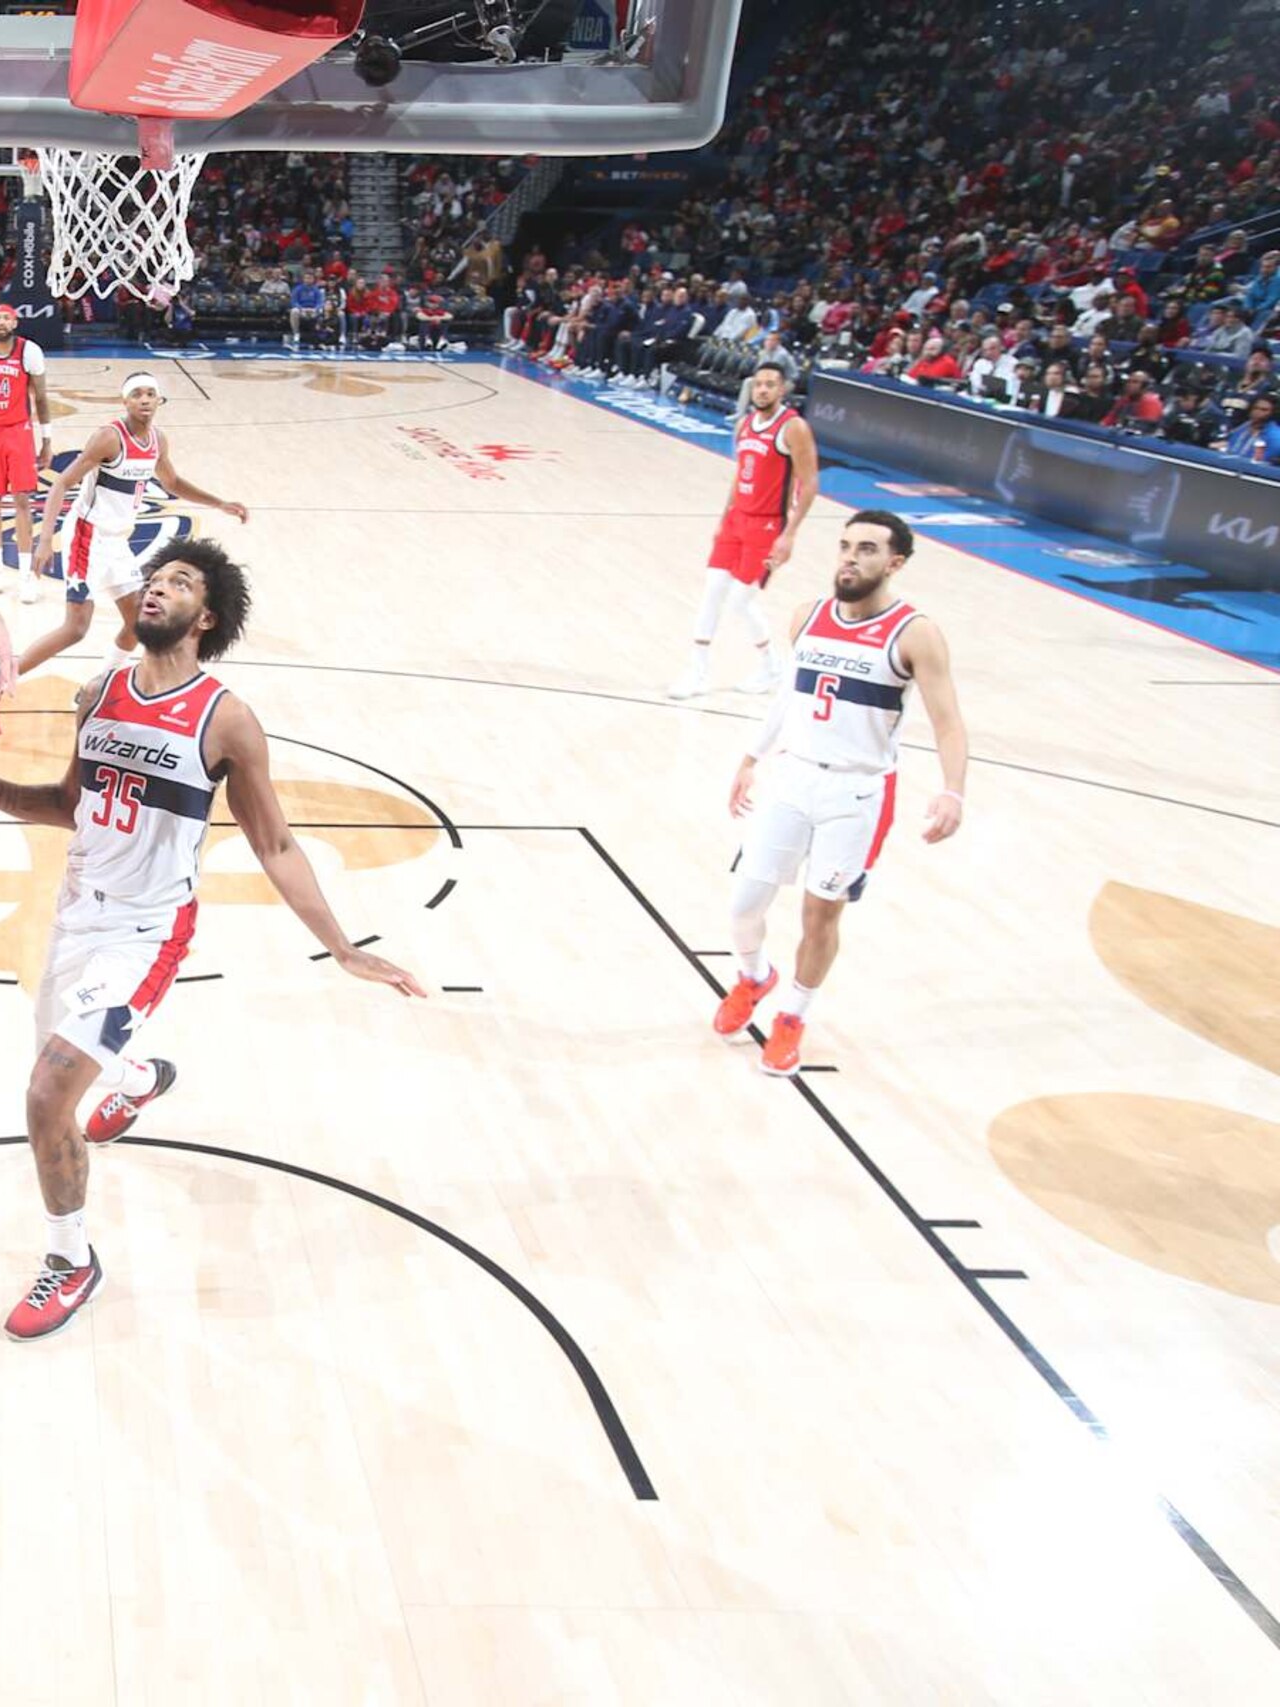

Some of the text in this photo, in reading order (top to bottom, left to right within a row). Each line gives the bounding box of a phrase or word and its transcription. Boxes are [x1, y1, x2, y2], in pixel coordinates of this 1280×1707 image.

[572, 16, 604, 42] NBA
[1207, 511, 1280, 548] KIA
[795, 646, 875, 675] wizards
[812, 673, 841, 722] 5
[84, 731, 183, 770] wizards
[90, 764, 148, 836] 35
